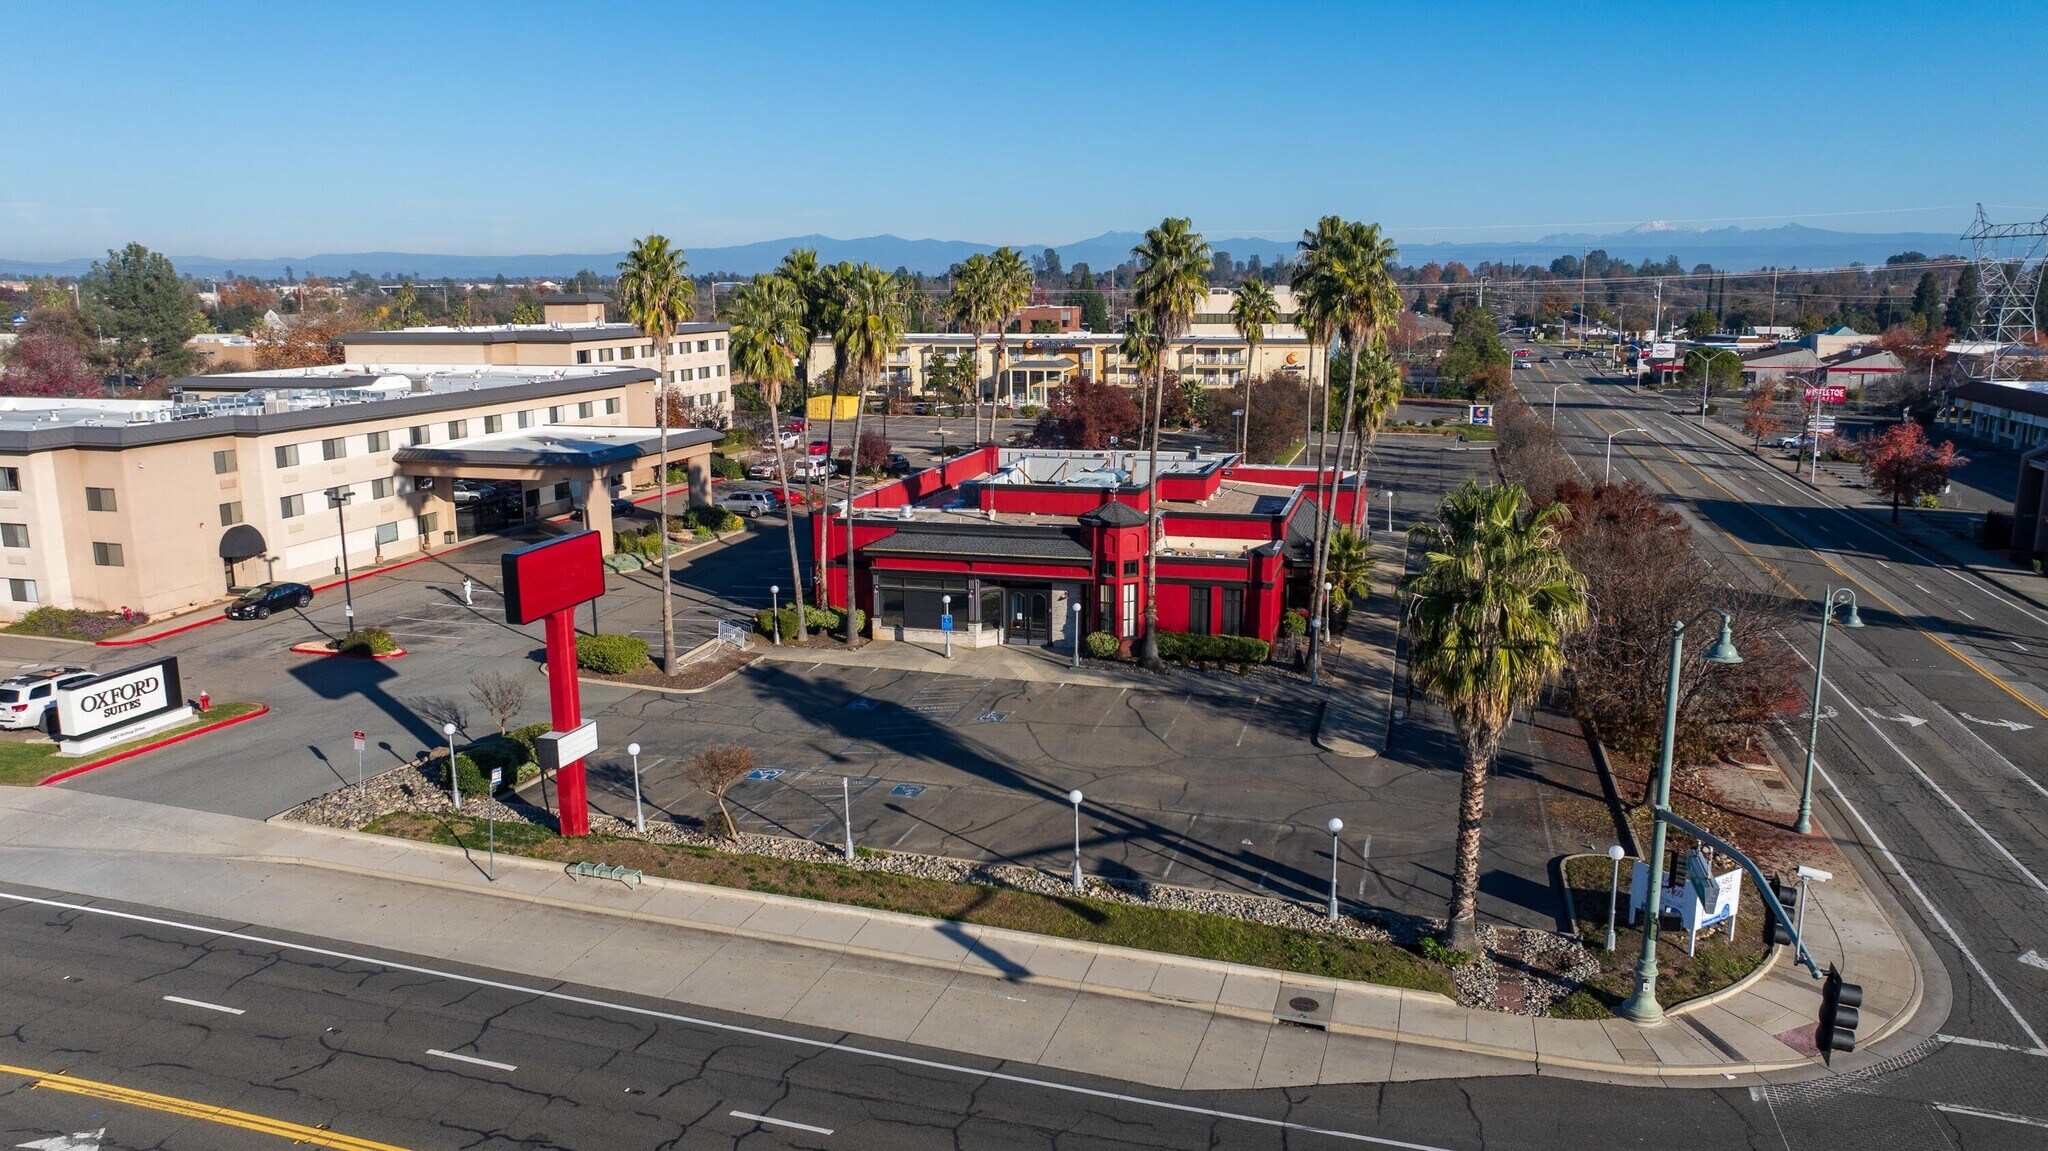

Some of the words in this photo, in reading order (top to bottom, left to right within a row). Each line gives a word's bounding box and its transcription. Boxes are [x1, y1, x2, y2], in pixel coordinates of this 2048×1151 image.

[1805, 388, 1845, 397] MISTLETOE
[81, 677, 159, 713] OXFORD
[103, 699, 141, 718] SUITES
